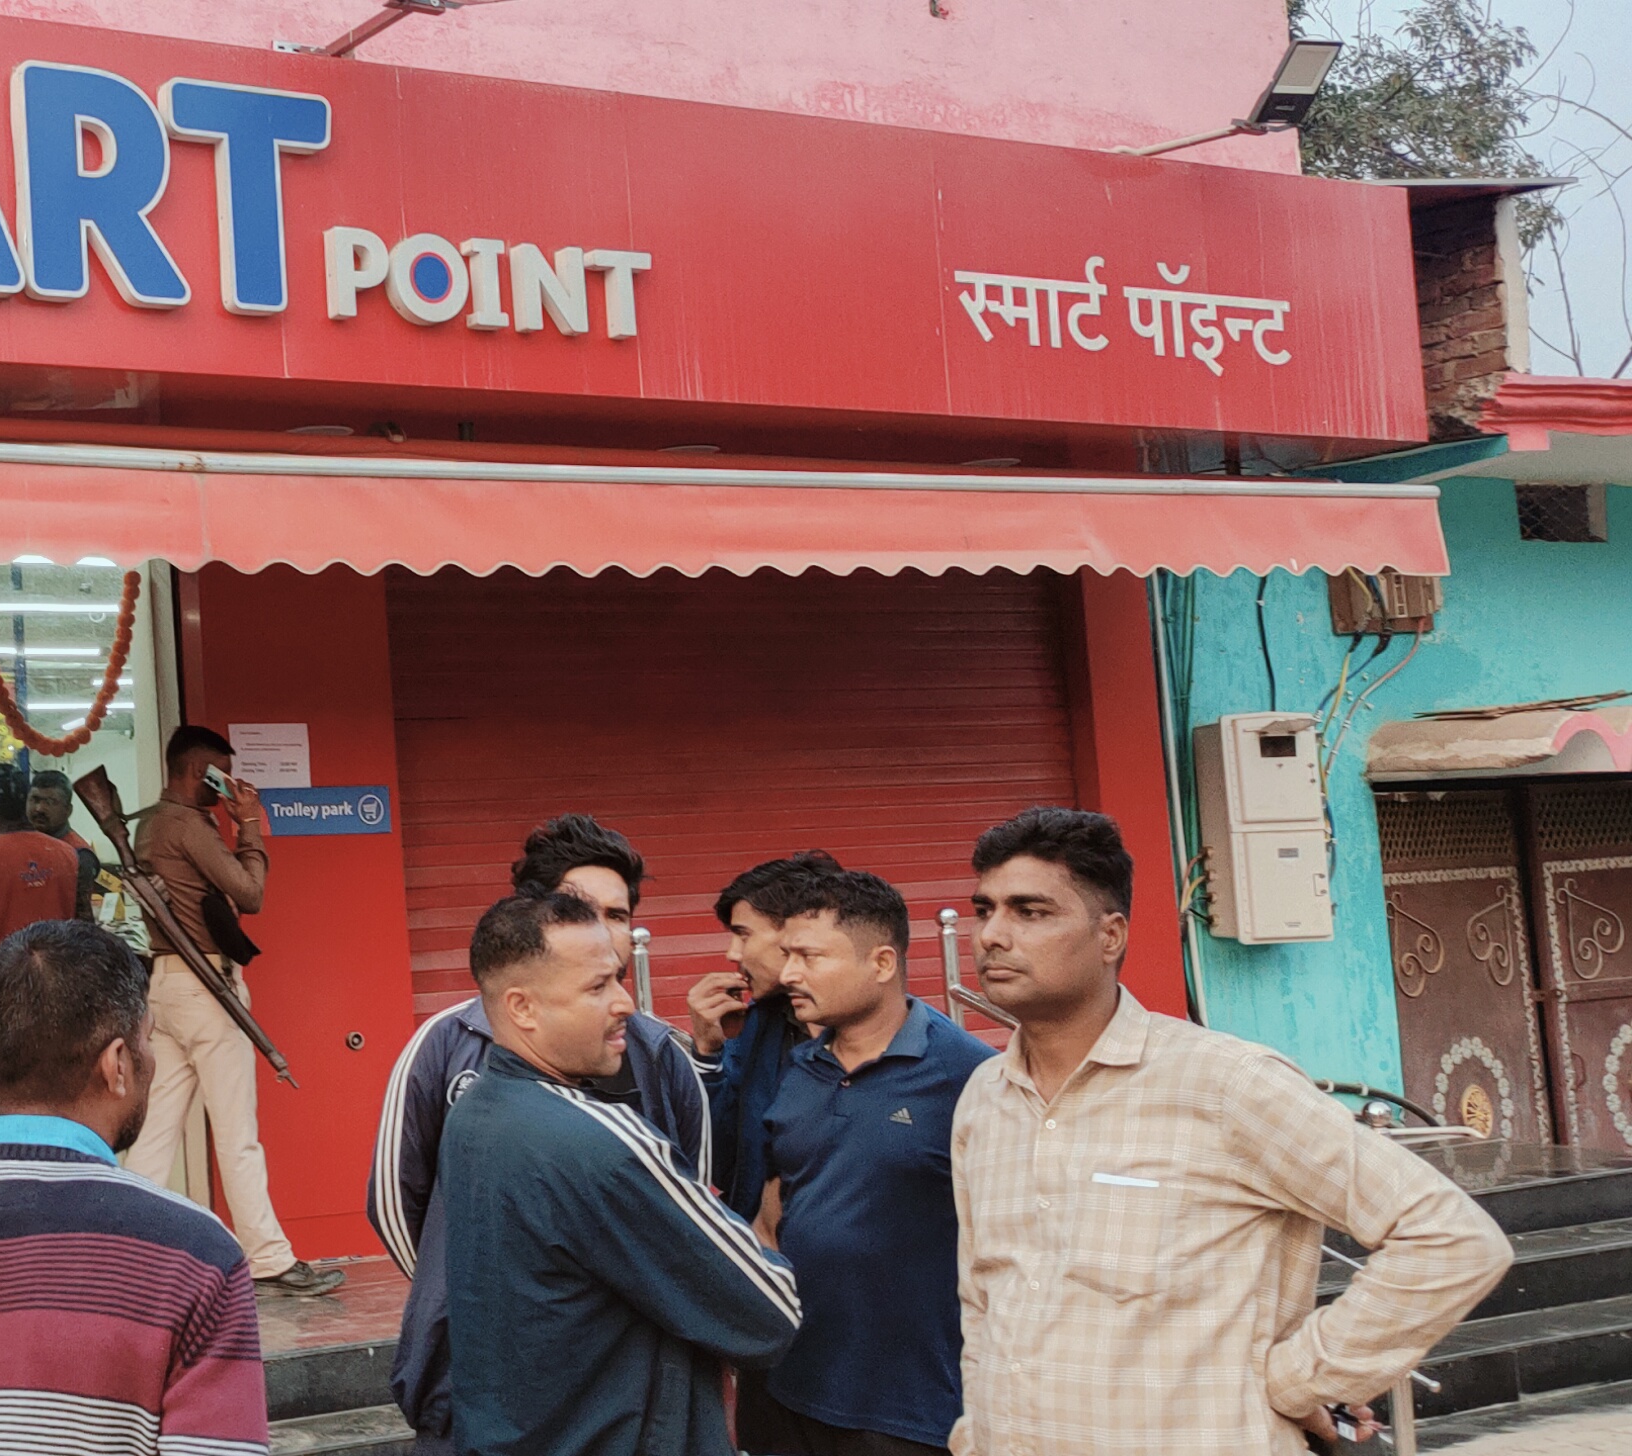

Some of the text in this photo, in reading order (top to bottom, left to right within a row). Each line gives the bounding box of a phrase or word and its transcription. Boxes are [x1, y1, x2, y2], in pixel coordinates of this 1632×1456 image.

[323, 226, 652, 340] POINT
[954, 255, 1293, 377] स्मार्ट पॉइन्ट
[271, 801, 354, 820] Trolley park
